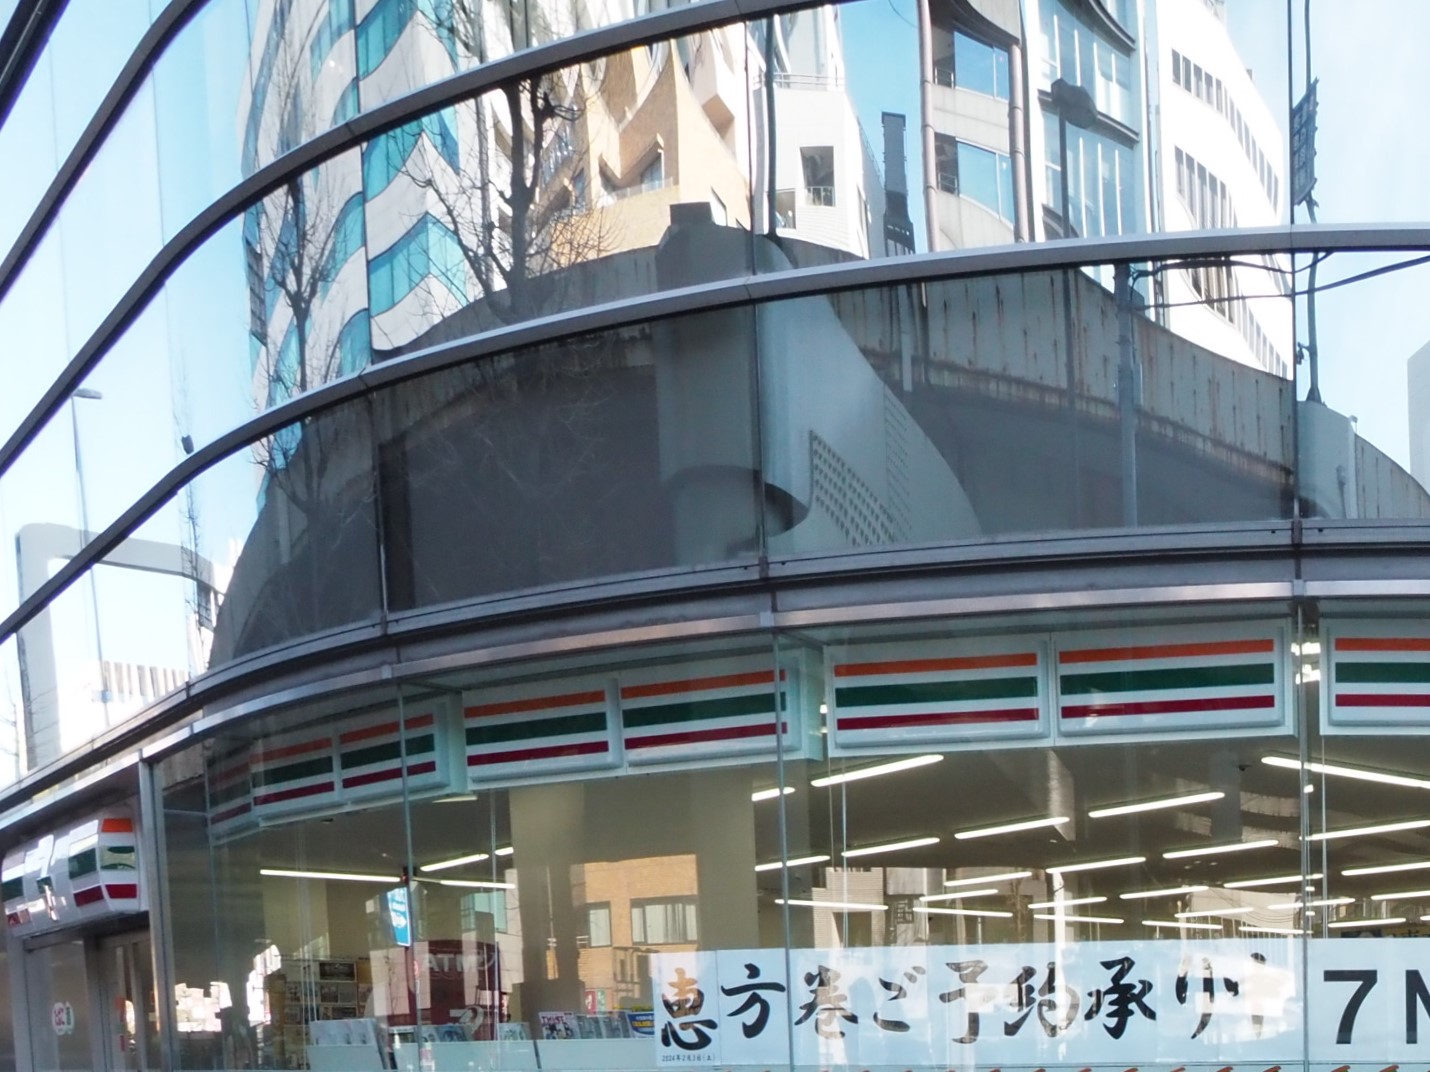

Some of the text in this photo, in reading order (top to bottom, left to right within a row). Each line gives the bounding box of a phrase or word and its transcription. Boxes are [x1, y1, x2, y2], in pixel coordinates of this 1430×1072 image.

[660, 951, 1268, 1051] 恵方巻ご予約承り
